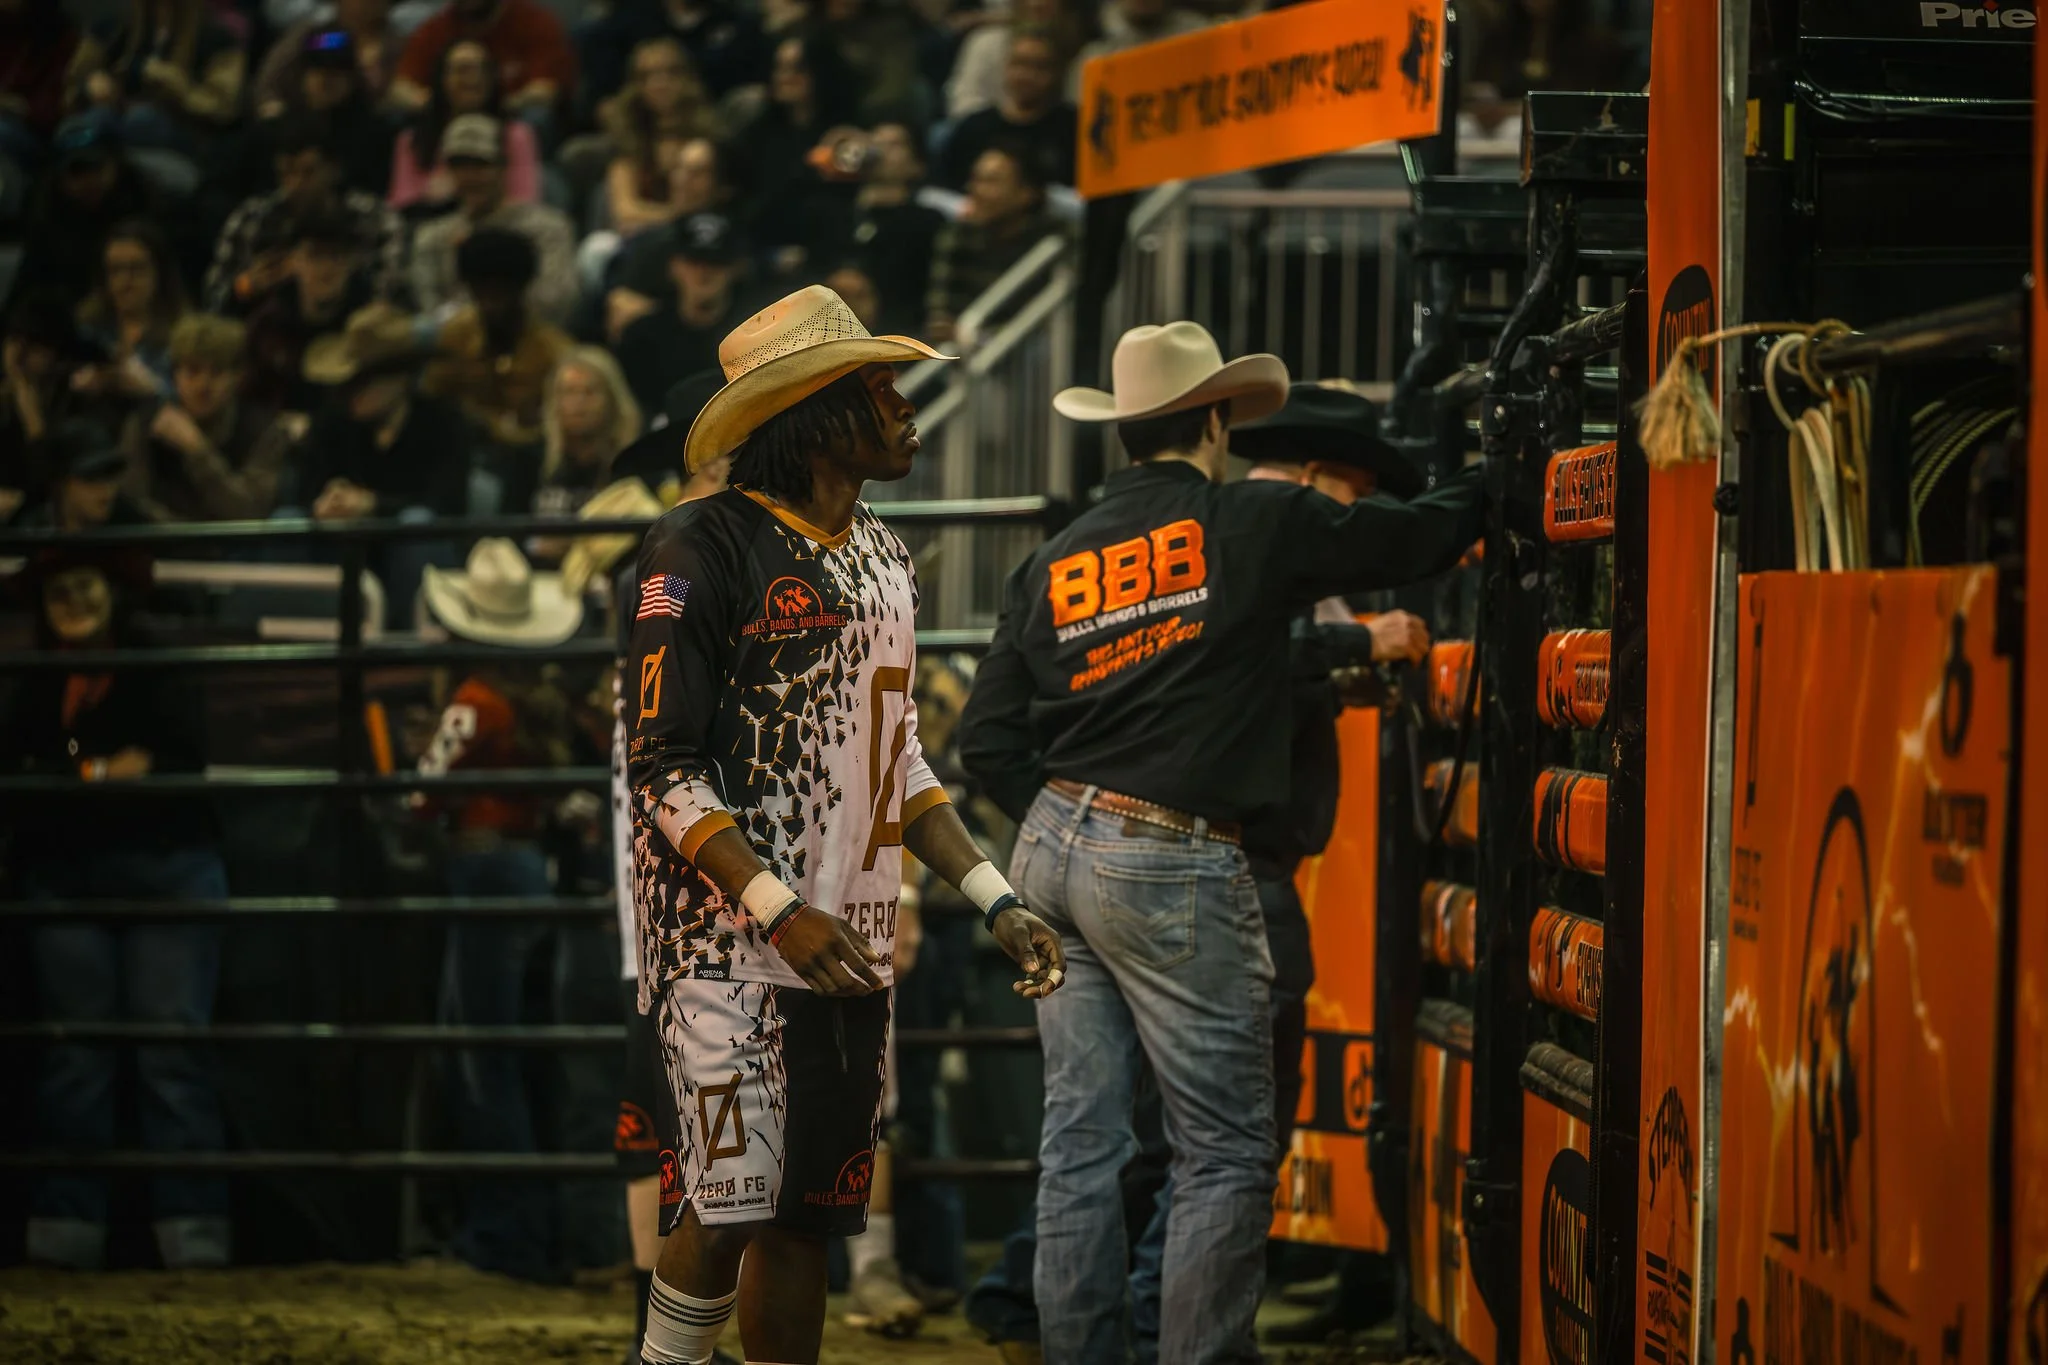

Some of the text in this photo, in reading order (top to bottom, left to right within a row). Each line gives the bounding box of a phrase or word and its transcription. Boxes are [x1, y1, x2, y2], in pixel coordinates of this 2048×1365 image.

[1048, 519, 1207, 627] BBB
[1148, 587, 1208, 614] BARRELS
[742, 621, 768, 636] BULLS,
[799, 617, 814, 628] AND
[815, 615, 846, 627] BARRELS
[1146, 616, 1182, 642] YOUR
